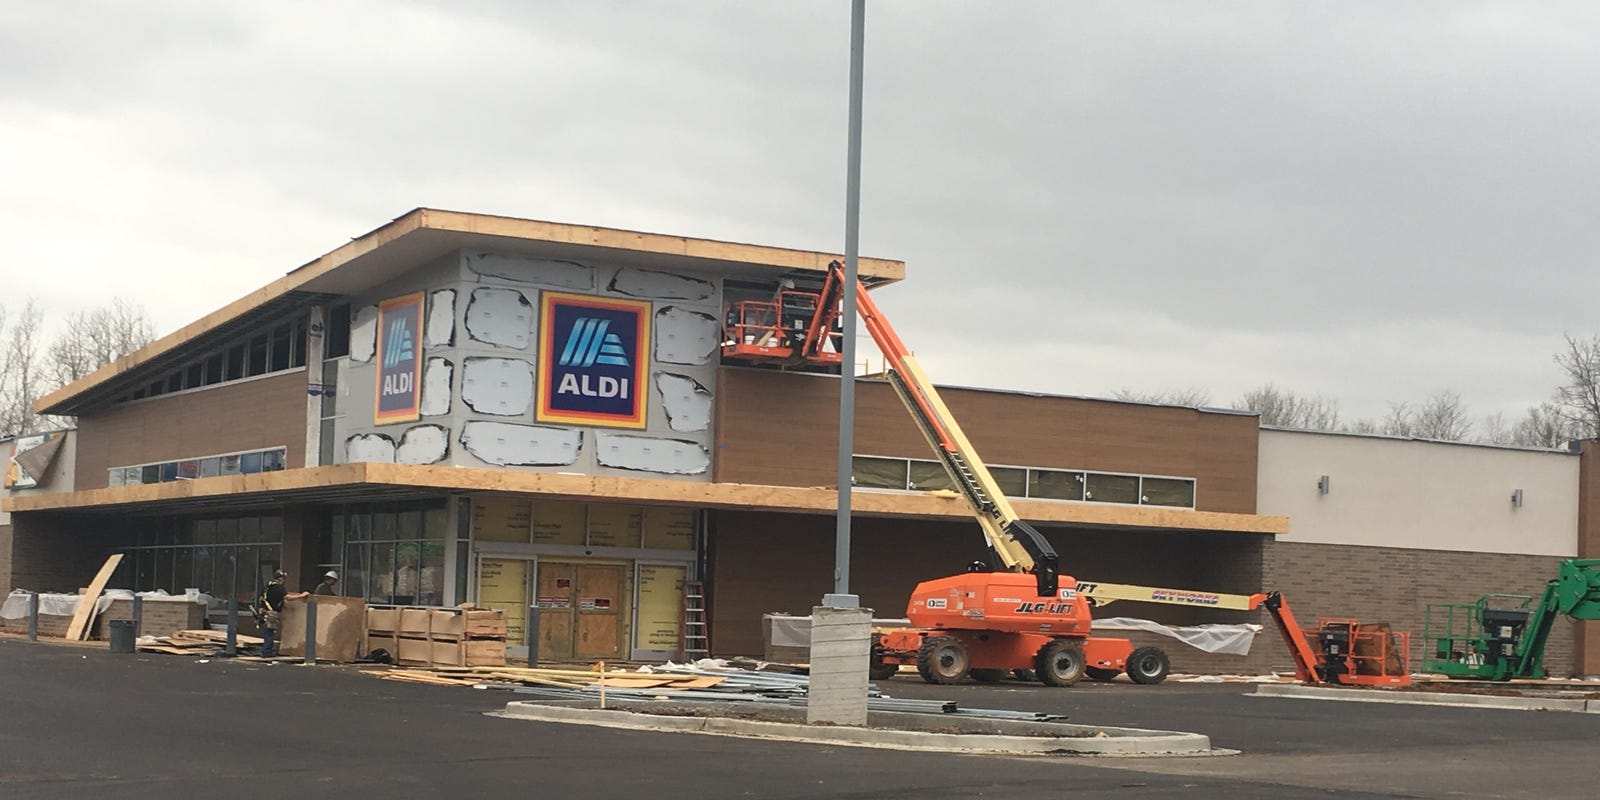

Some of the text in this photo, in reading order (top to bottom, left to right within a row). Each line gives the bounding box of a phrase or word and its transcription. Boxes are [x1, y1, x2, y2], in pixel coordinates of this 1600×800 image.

[383, 371, 413, 396] ALDI
[557, 373, 628, 399] ALDI
[1075, 583, 1098, 593] IFT
[1015, 602, 1073, 614] JLG LIFT
